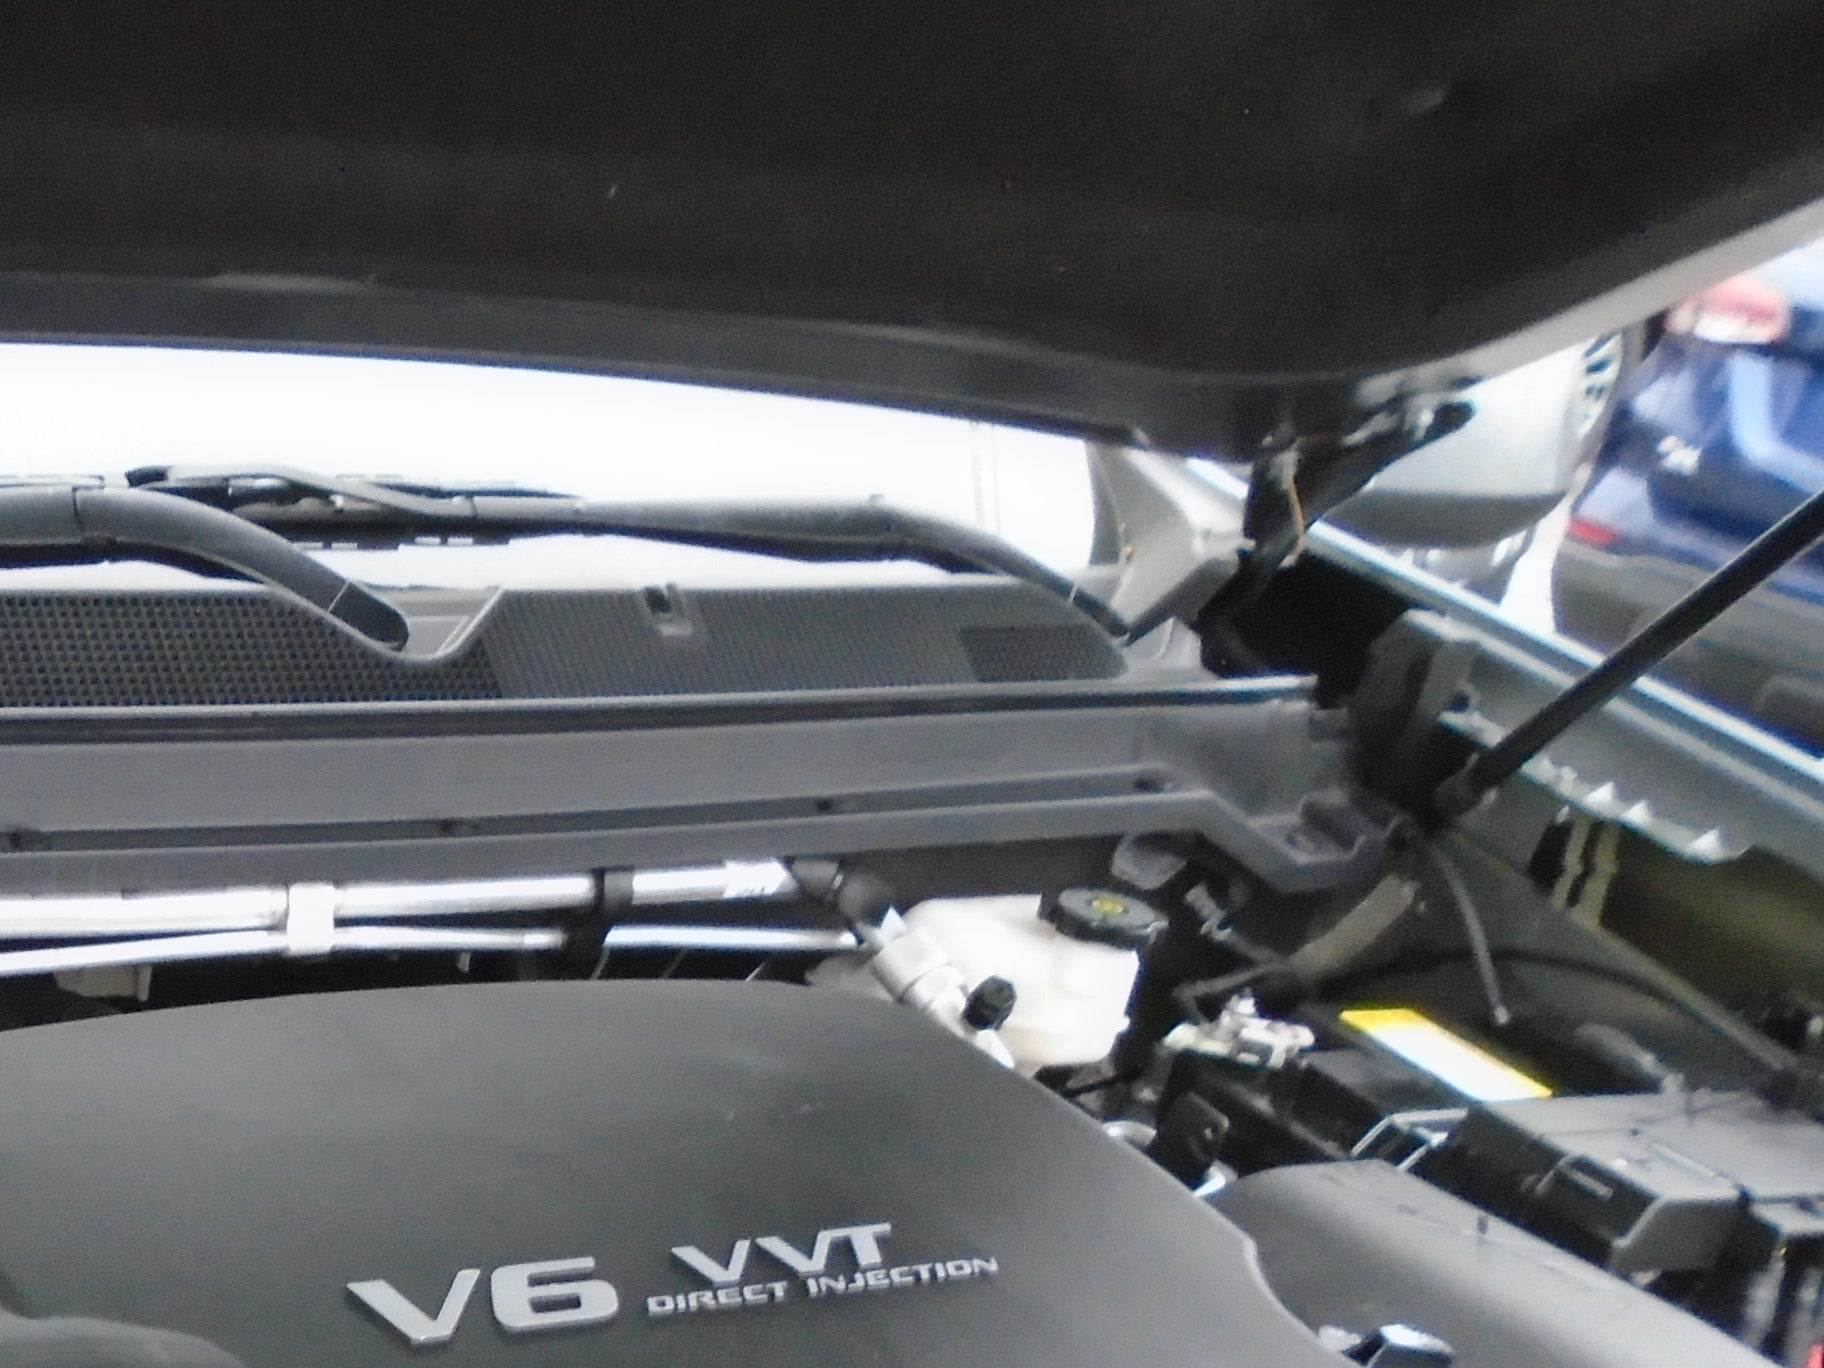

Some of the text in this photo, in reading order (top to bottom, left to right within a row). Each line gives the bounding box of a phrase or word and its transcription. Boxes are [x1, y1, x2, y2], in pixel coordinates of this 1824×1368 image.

[345, 1222, 892, 1345] V6 VVT
[646, 1256, 999, 1316] DIRECT INJECTION
